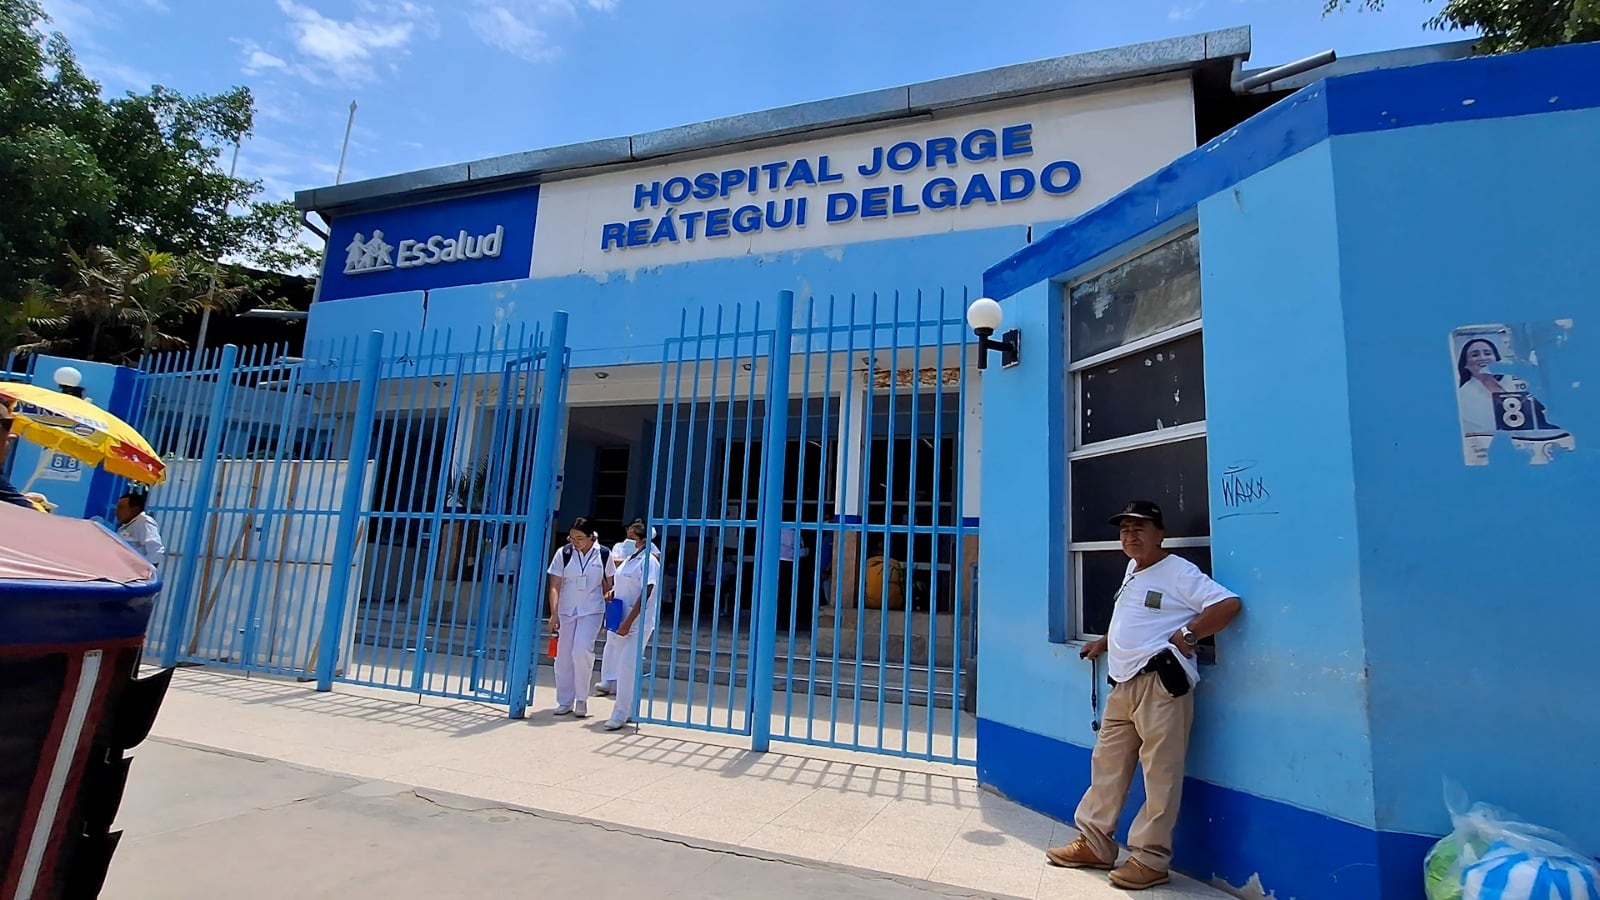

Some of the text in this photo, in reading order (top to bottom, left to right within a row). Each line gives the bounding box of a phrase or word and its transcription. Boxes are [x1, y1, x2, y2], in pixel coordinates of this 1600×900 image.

[633, 123, 1034, 211] HOSPITAL JORGE
[600, 160, 1083, 252] REÁTEGUI DELGADO
[396, 225, 504, 269] EsSalud
[1502, 397, 1526, 428] 8
